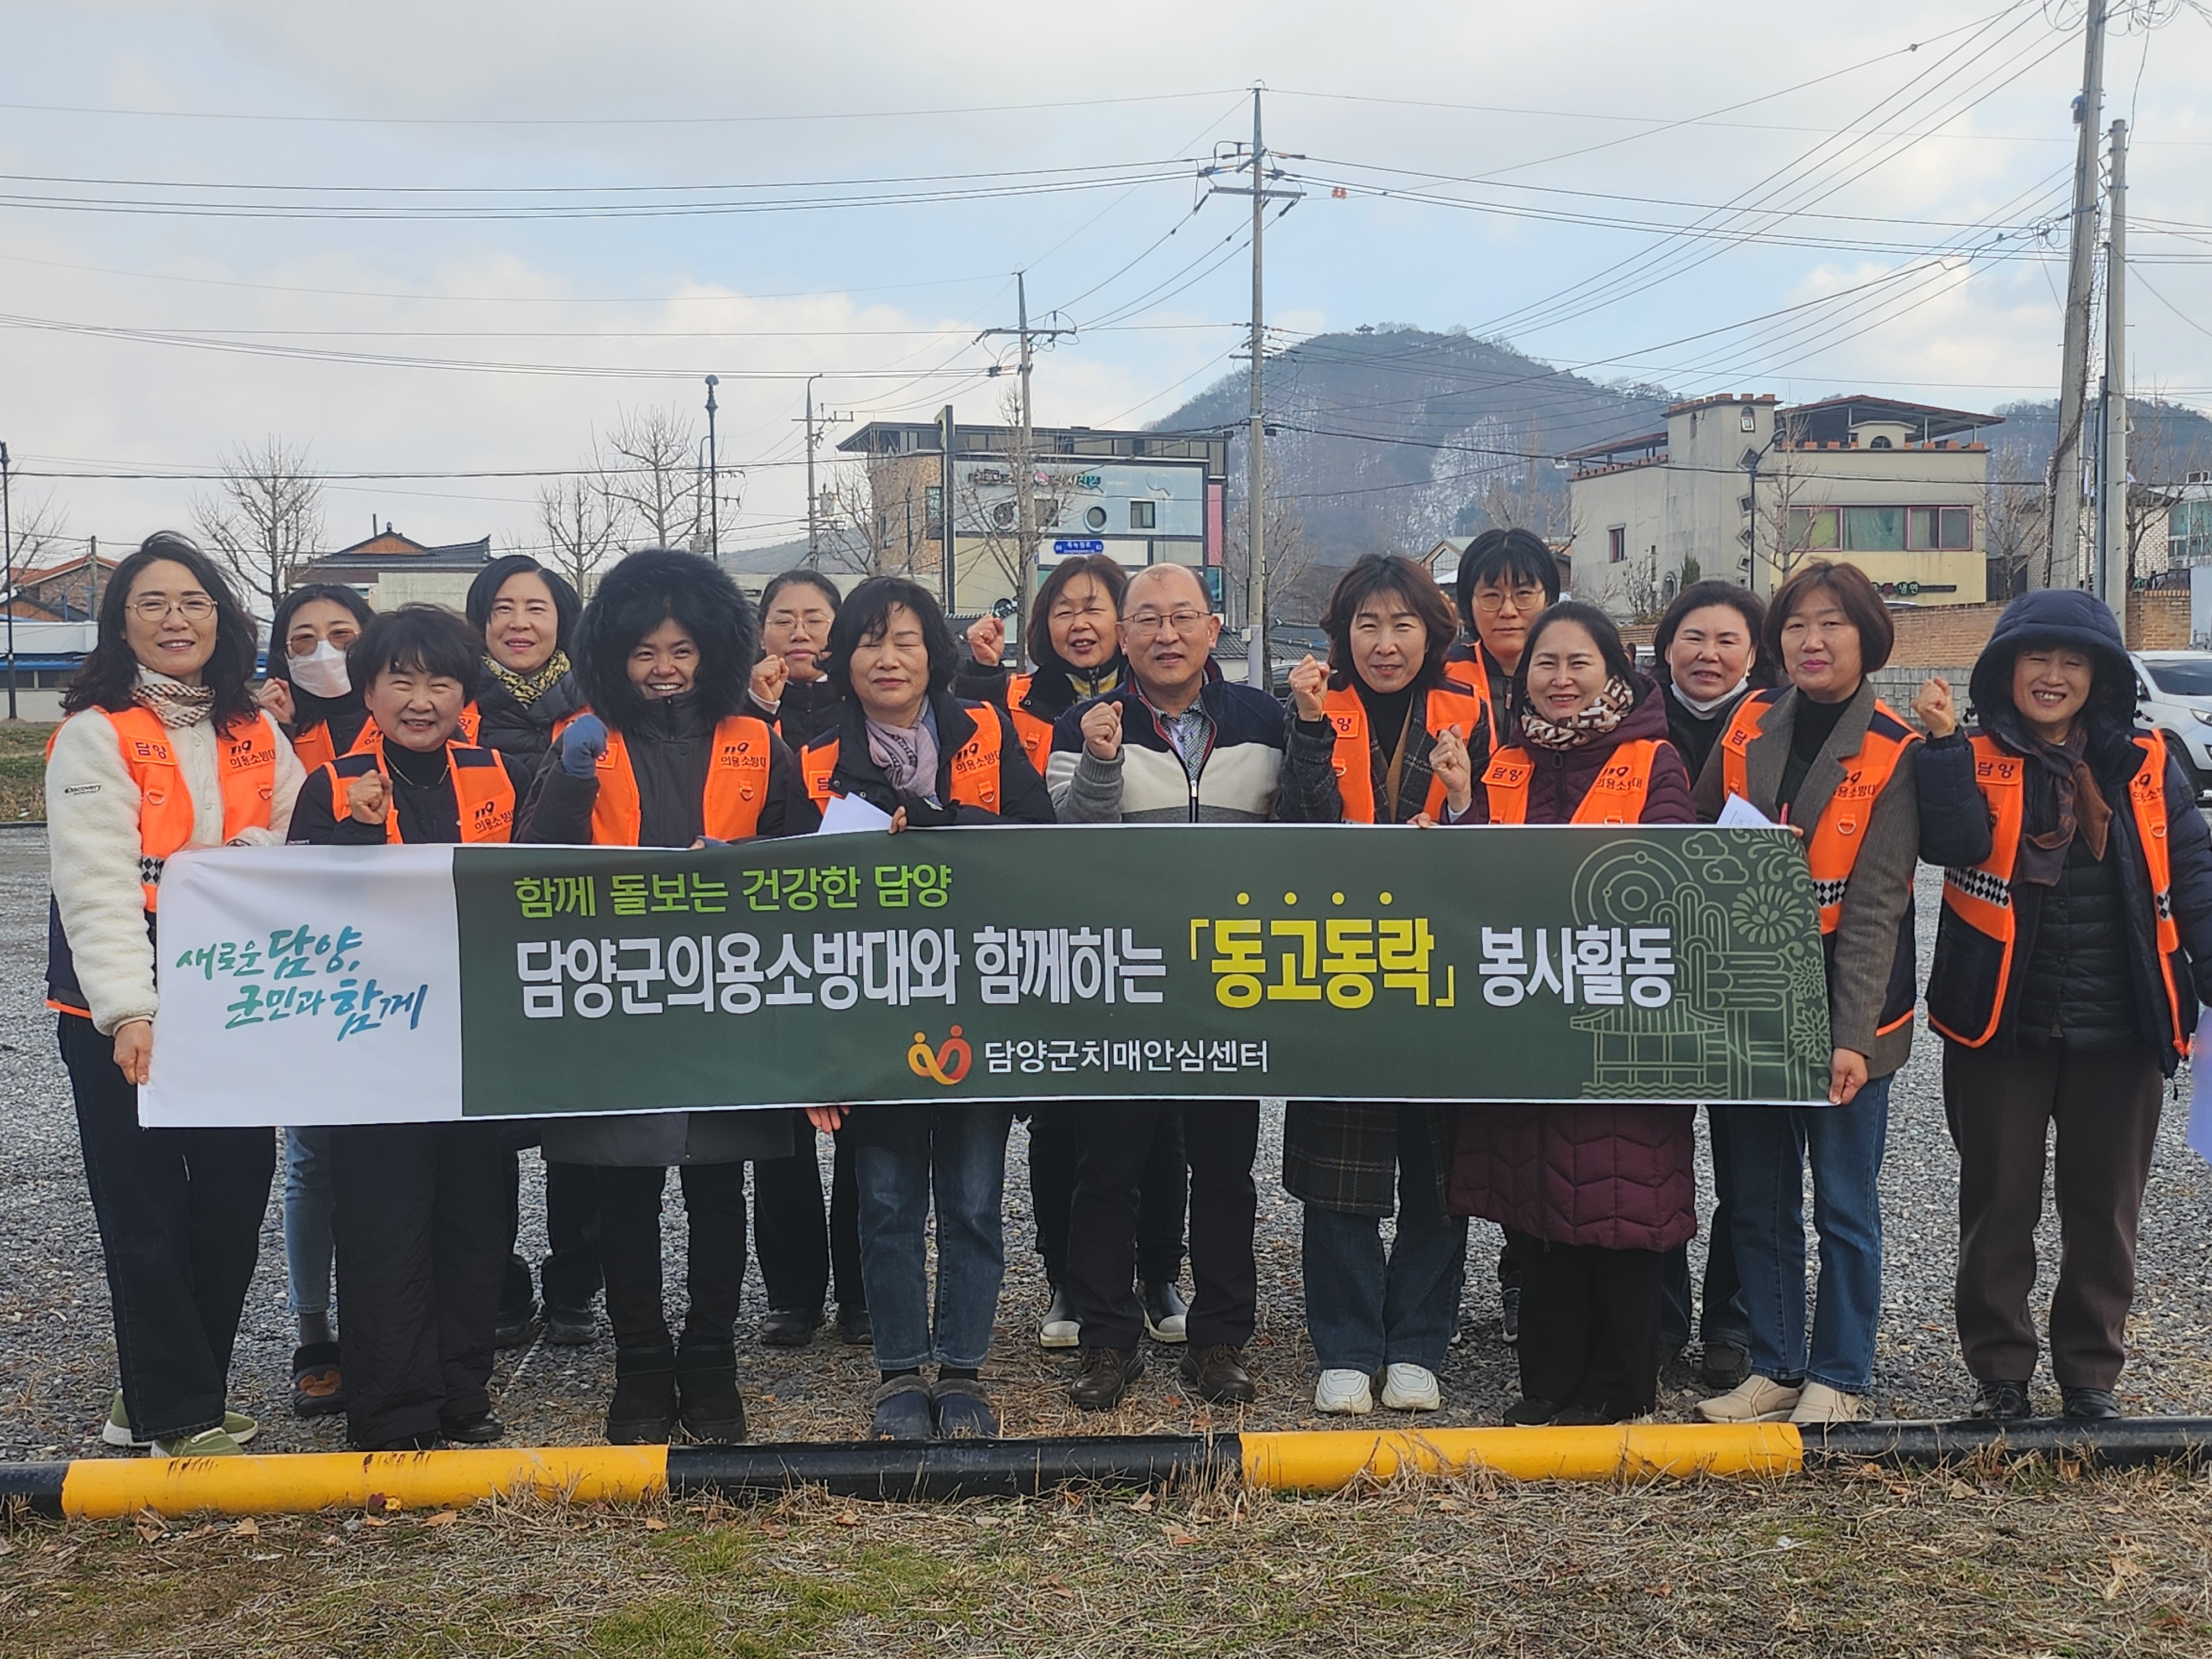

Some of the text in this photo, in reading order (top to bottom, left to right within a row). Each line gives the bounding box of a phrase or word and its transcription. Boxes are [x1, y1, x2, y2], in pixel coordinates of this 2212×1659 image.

[1899, 583, 1918, 594] 냉면
[458, 718, 471, 731] 양
[1336, 718, 1352, 731] 양
[1731, 729, 1747, 747] 담
[135, 742, 166, 759] 담양
[1492, 767, 1522, 782] 담양
[1977, 761, 2015, 779] 담양
[514, 864, 952, 918] 함께 돌보는 건강한 담양
[176, 940, 265, 980] 새로운
[517, 928, 961, 1019] 담양군의용소방대와
[973, 926, 1166, 1005] 함께하는
[1479, 925, 1676, 1008] 봉사활동
[225, 978, 429, 1042] 군민과 함께
[985, 1040, 1268, 1073] 담양군치매안심센터
